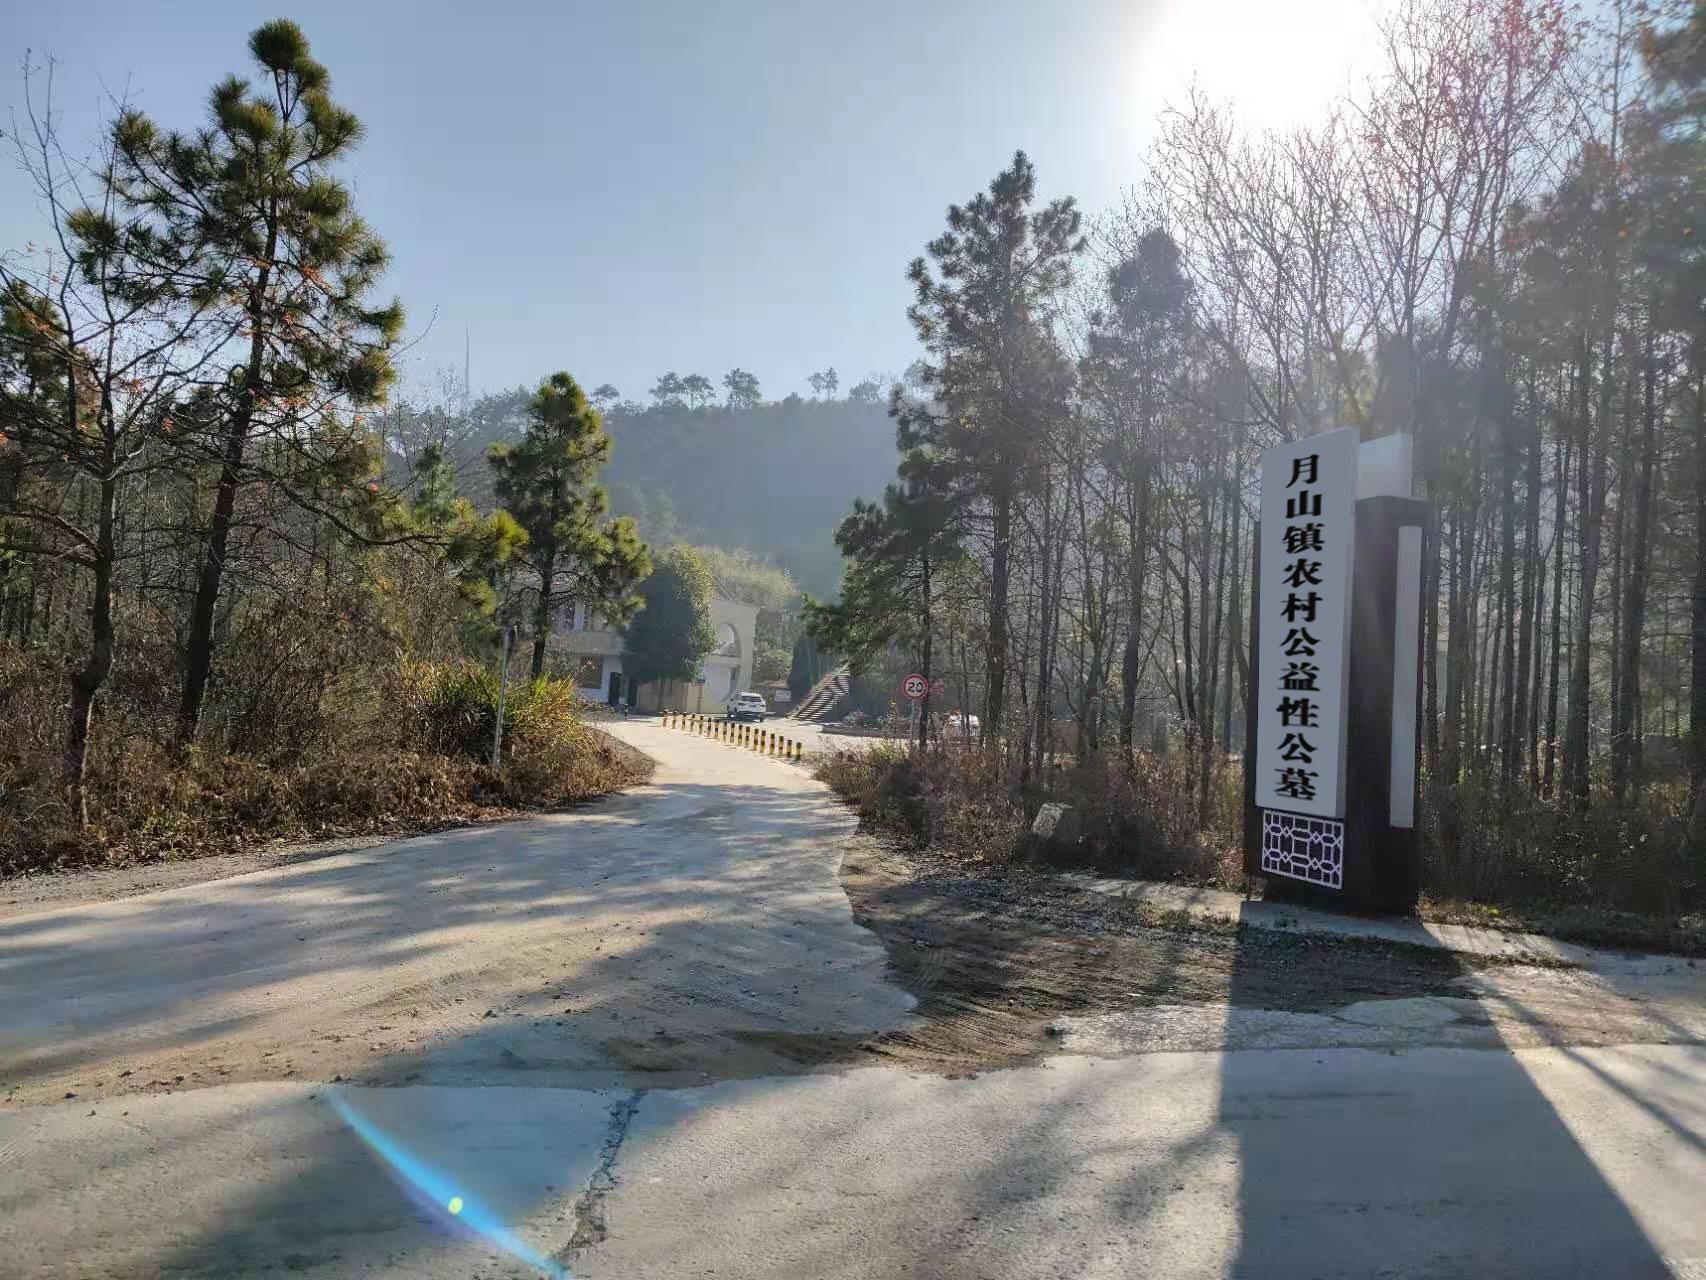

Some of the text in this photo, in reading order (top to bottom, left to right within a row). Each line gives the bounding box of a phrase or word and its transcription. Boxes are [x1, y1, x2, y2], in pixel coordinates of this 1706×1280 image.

[907, 681, 924, 693] 20
[1274, 454, 1325, 802] 月山镇农村公益性公墓
